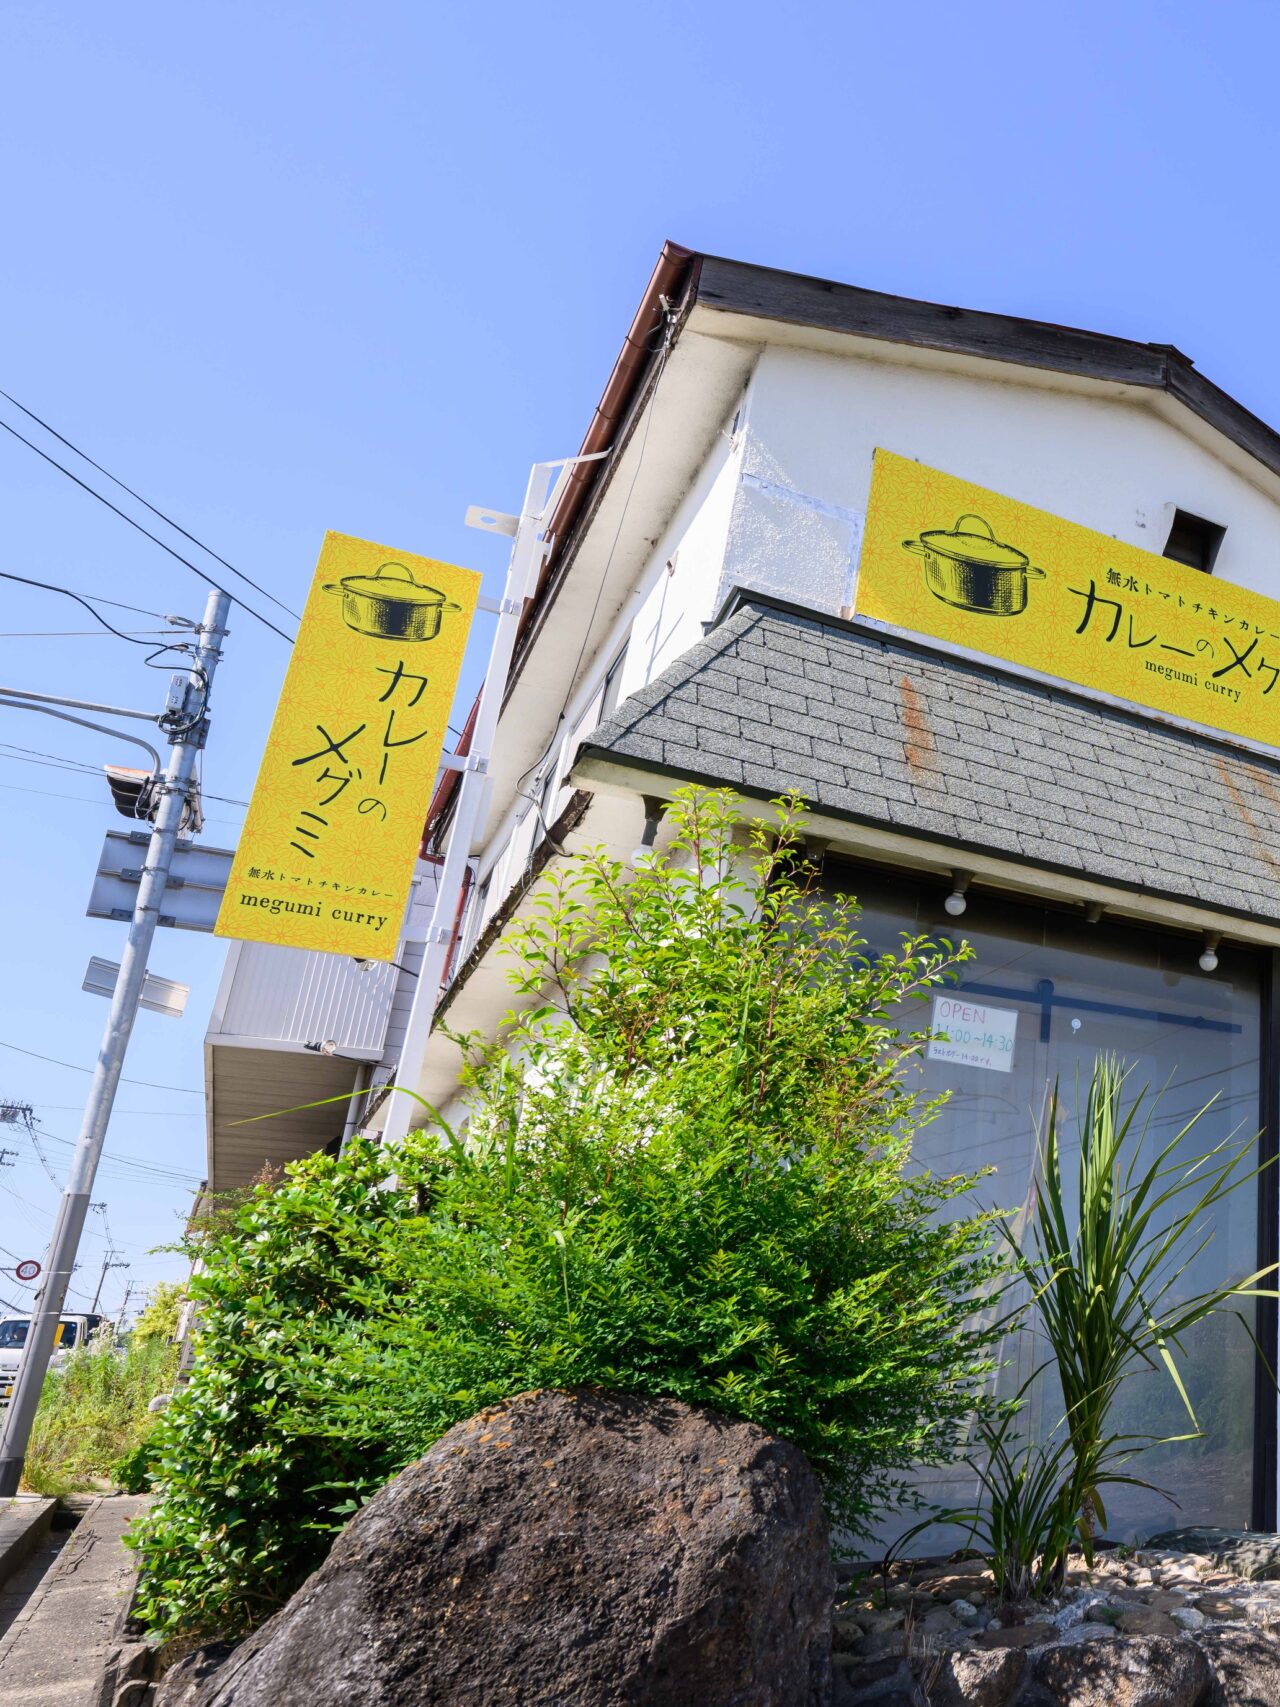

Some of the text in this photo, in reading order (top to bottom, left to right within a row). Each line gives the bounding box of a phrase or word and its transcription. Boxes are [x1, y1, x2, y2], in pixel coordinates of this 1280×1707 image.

[1105, 567, 1280, 639] 無水トマトチキンカレー
[1145, 660, 1241, 702] megumi curry
[357, 660, 428, 822] カレーの
[291, 724, 367, 858] メグミ
[248, 866, 394, 898] 無水トマトチキンカレー
[240, 893, 388, 931] megumi curry
[940, 1000, 987, 1025] OPEN
